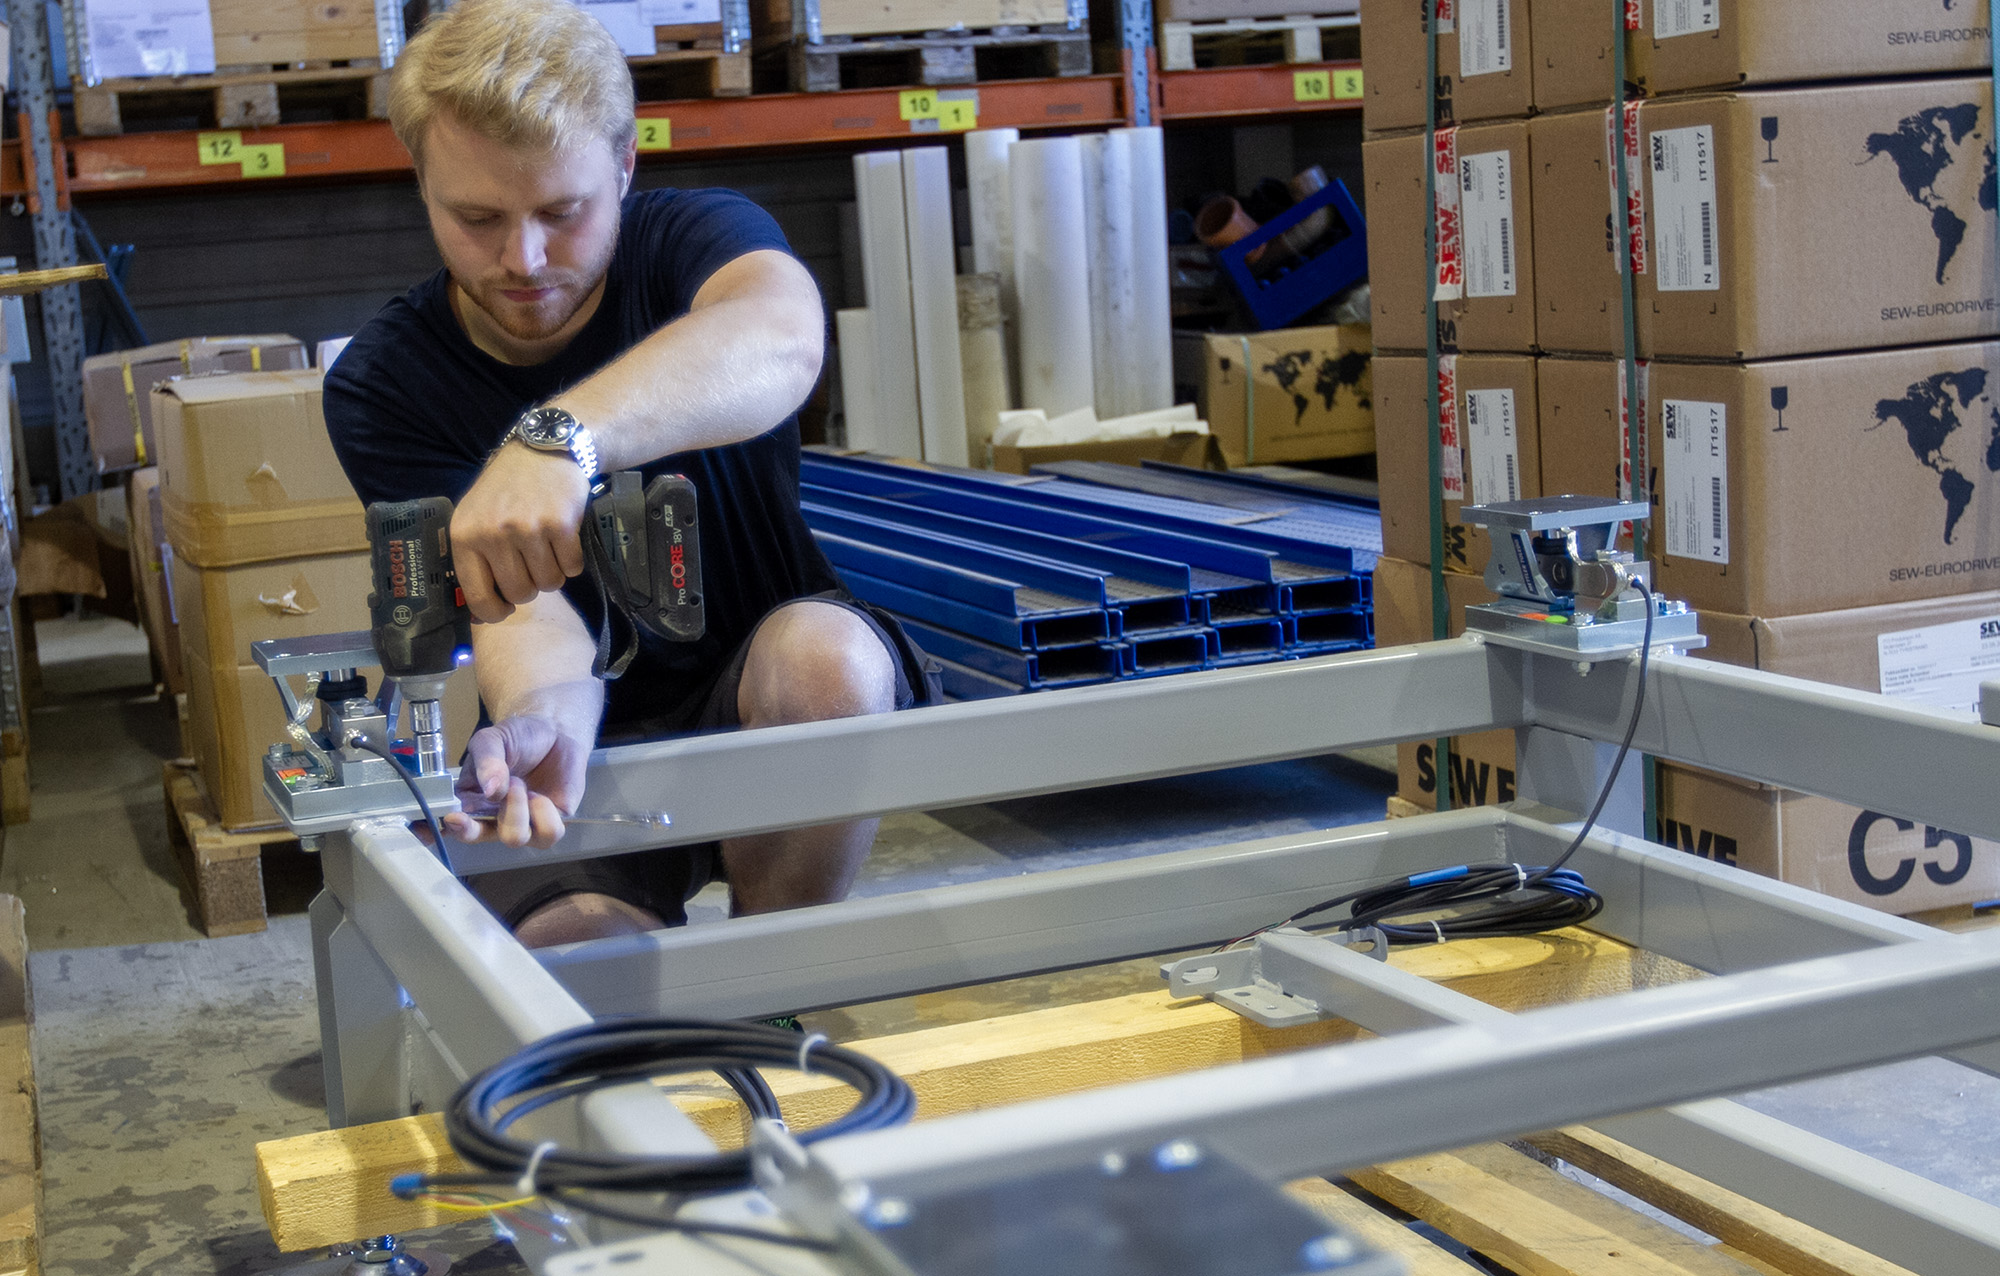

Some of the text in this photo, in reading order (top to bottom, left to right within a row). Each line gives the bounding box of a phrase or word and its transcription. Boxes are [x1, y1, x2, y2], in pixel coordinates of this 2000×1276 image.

[1886, 26, 1993, 46] SEW-EURODRIV
[1304, 78, 1323, 95] 10
[910, 97, 930, 113] 10
[953, 107, 961, 123] 1
[645, 126, 657, 142] 2
[209, 139, 233, 158] 12
[257, 152, 270, 170] 3
[1696, 132, 1707, 182] IT1517
[1439, 208, 1456, 285] SEW
[1452, 203, 1462, 285] EURODRIVE
[1503, 280, 1510, 290] N
[1704, 273, 1712, 284] N
[1880, 297, 1995, 321] SEW-EURODRIVE
[1438, 370, 1454, 447] SEW
[1666, 403, 1675, 439] SEW
[1710, 407, 1719, 457] IT1517
[1713, 545, 1721, 557] N
[389, 540, 407, 598] BOSCH
[406, 540, 419, 597] Professional
[1889, 556, 2000, 582] SEW-EURODRIVE
[1416, 743, 1490, 808] SW
[1848, 809, 1973, 897] C5
